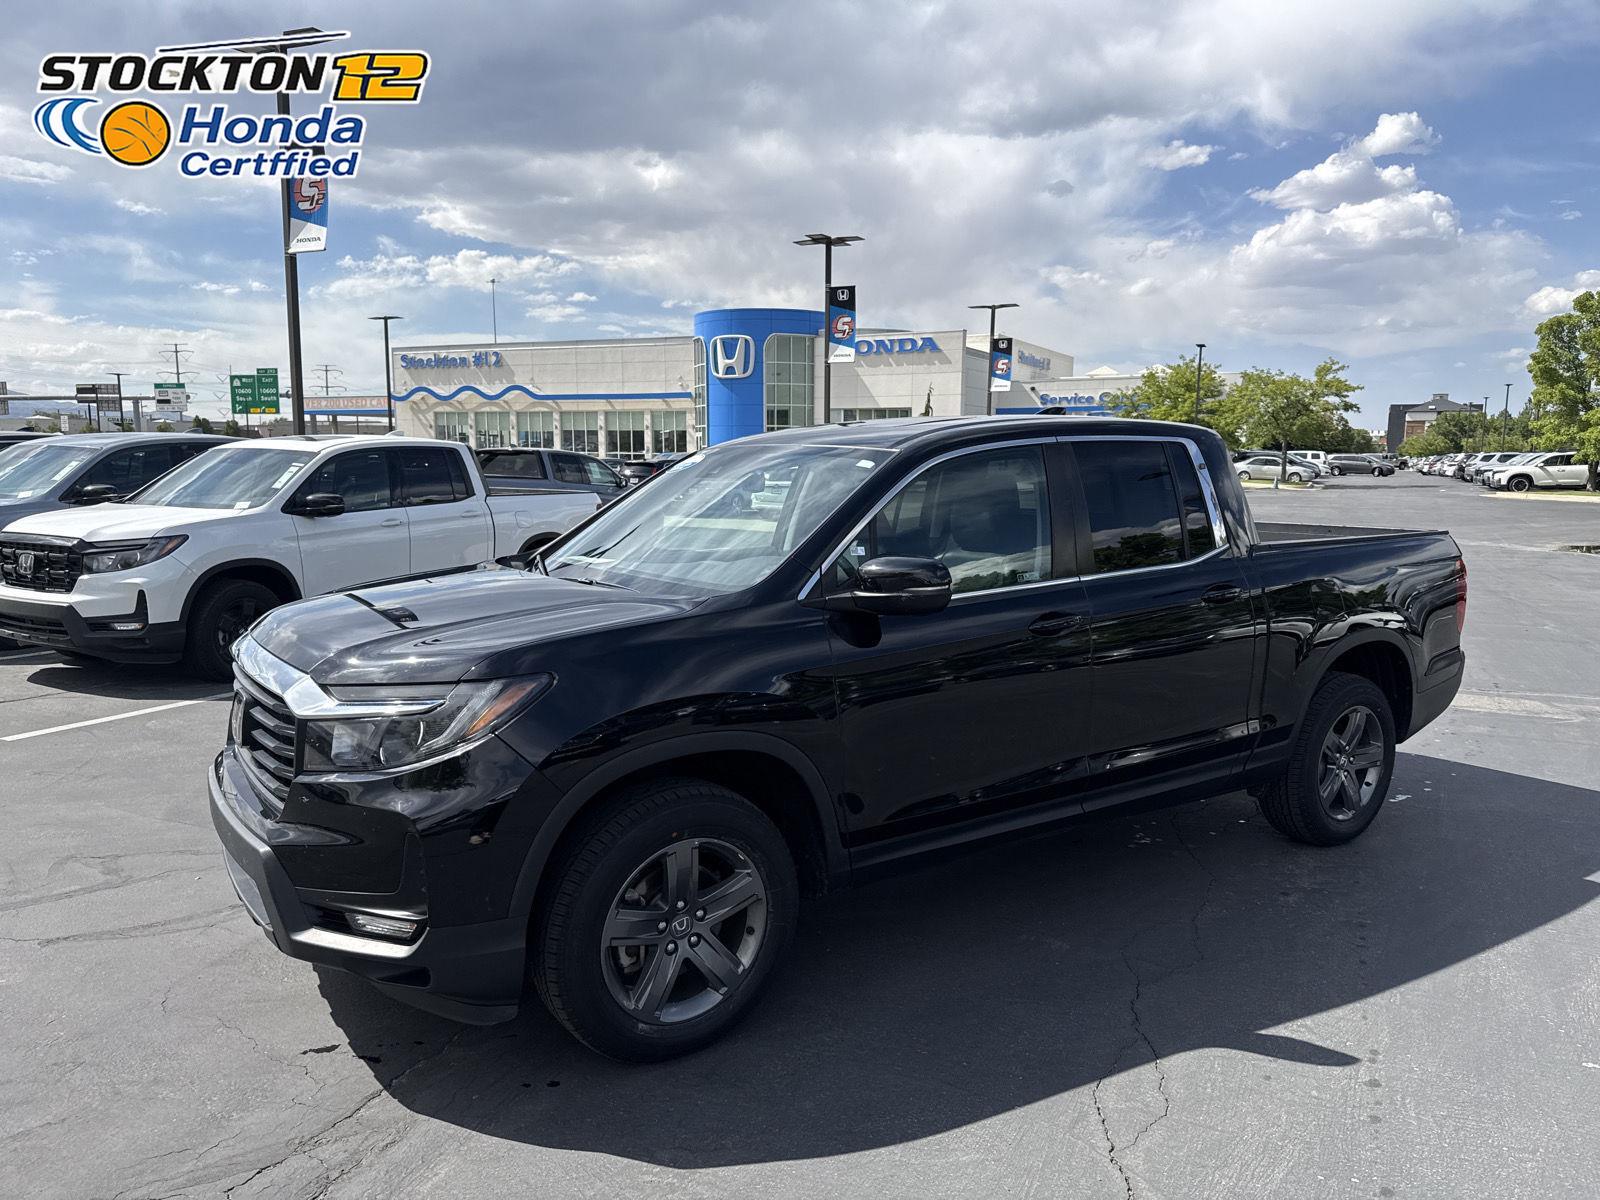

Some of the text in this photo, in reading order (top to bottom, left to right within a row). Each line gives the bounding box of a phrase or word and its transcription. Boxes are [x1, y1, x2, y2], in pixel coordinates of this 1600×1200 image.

[296, 236, 322, 244] HONDA
[855, 336, 944, 356] ONDA
[304, 398, 322, 408] VER
[323, 398, 341, 408] 200
[342, 398, 367, 408] USED
[1040, 392, 1095, 405] Service
